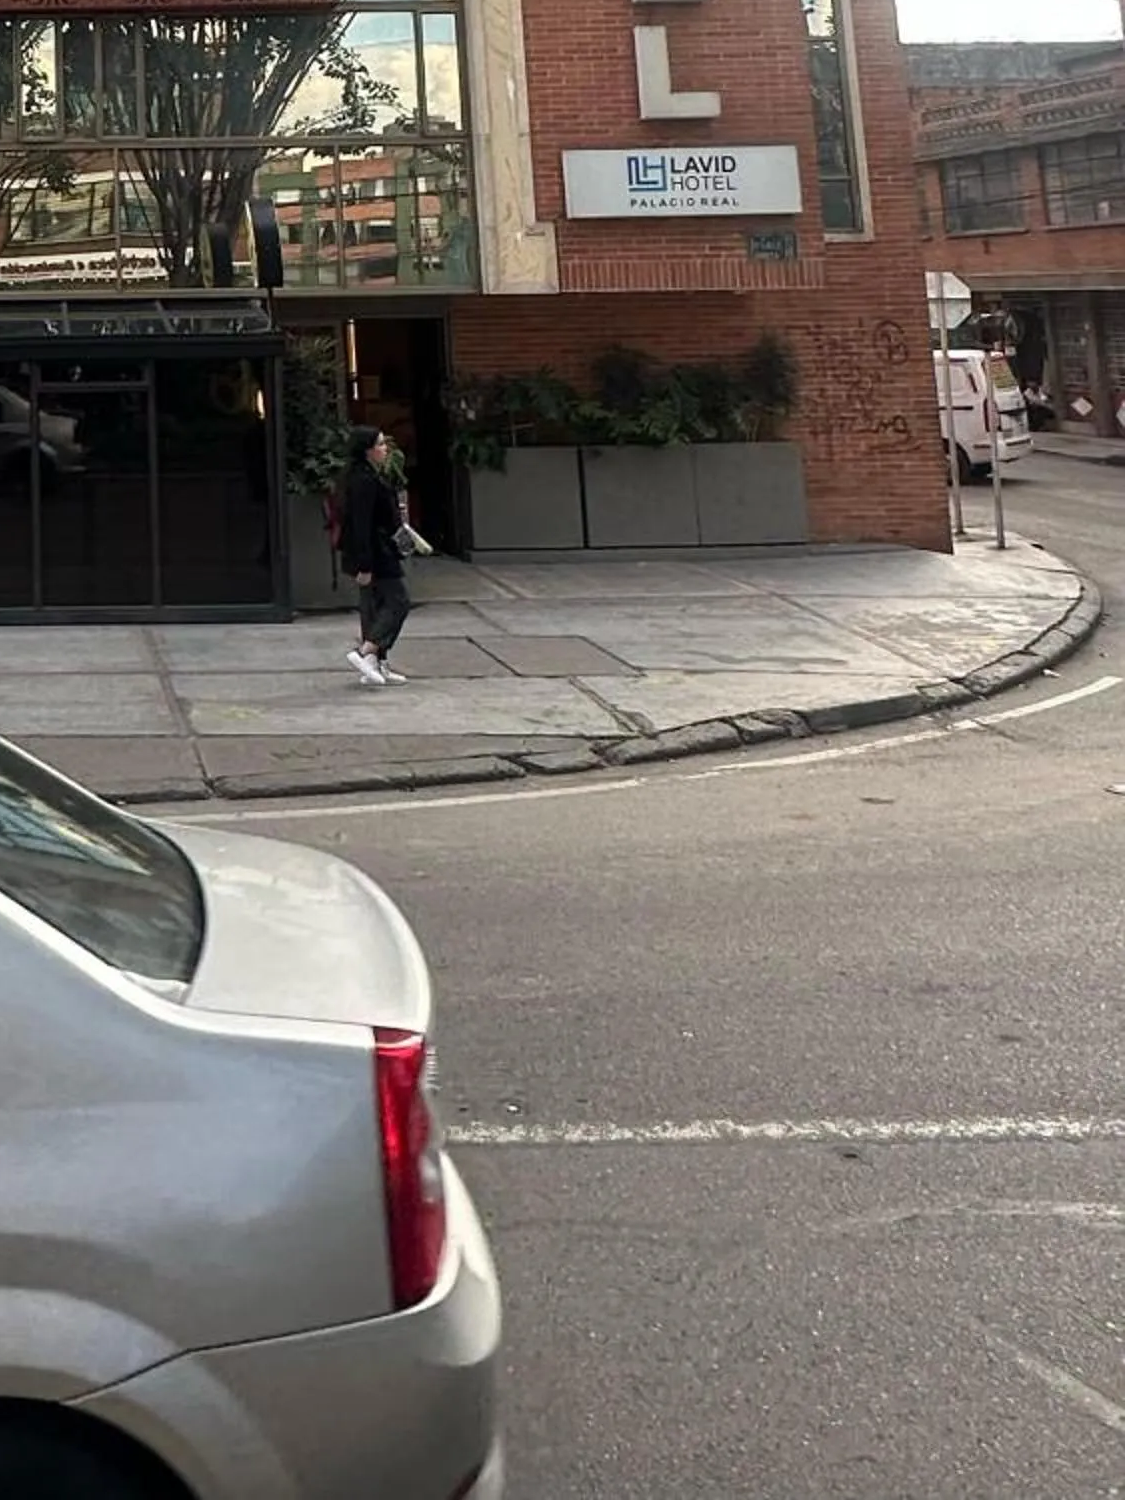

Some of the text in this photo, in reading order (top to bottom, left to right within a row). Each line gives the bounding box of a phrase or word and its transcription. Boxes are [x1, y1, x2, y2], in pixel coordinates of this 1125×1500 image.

[670, 155, 736, 174] LAVID
[670, 175, 738, 191] HOTEL
[630, 196, 740, 208] PALACIO REAL
